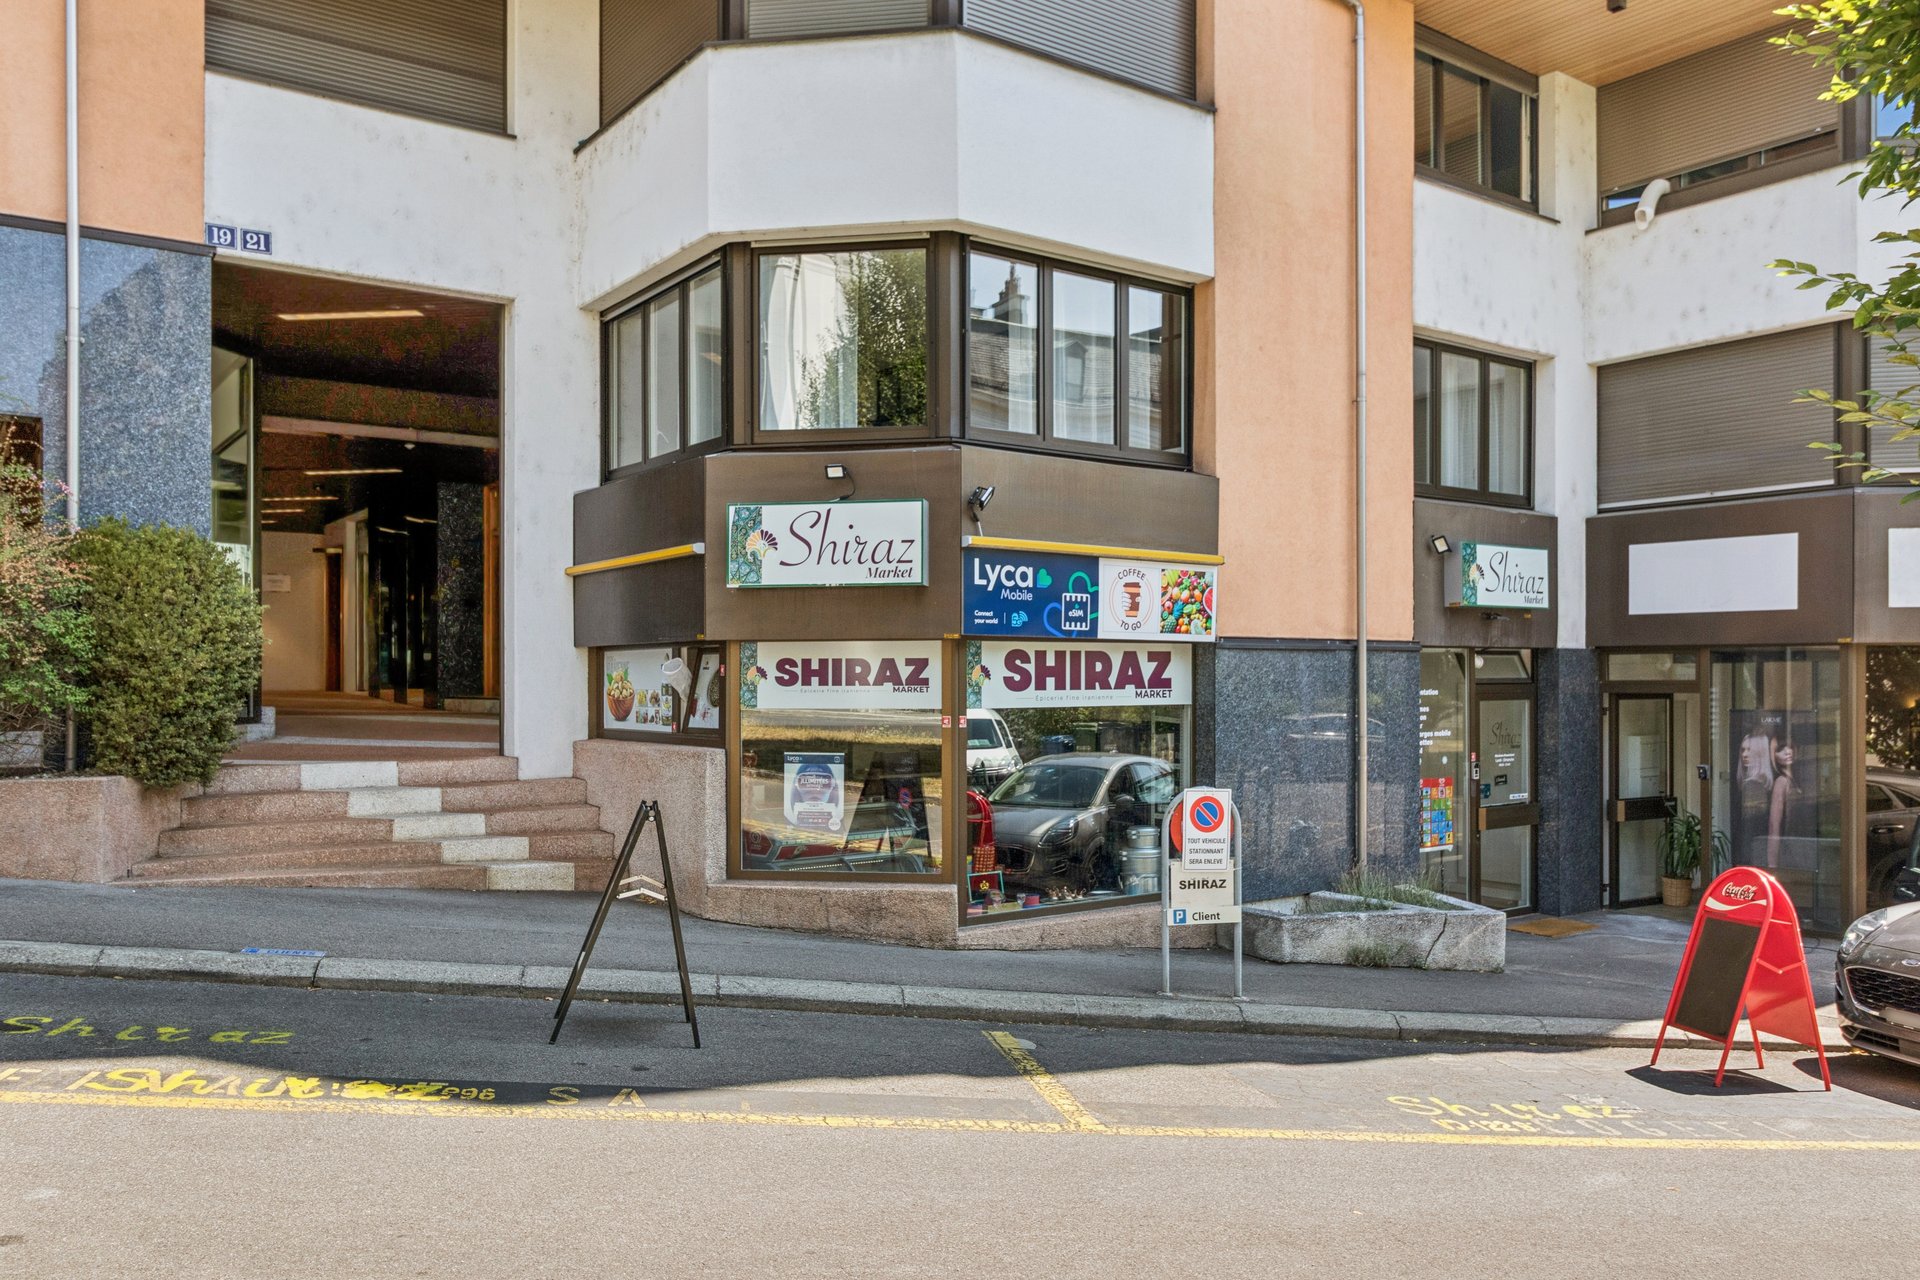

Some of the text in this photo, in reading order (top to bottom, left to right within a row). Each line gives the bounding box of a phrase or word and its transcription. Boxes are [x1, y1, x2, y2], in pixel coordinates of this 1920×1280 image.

[212, 227, 231, 245] 19
[246, 233, 266, 251] 21
[779, 508, 915, 566] Shiraz
[865, 566, 913, 578] Market
[974, 557, 1034, 591] Lyca
[1117, 568, 1146, 581] COFFEE
[1485, 550, 1545, 594] Shiraz
[1000, 588, 1033, 601] Mobile
[1524, 595, 1544, 604] Market
[974, 609, 993, 617] Connect
[1068, 609, 1084, 617] eSIM
[1120, 620, 1142, 631] TO GO
[774, 657, 930, 687] SHIRAZ
[1002, 648, 1173, 692] SHIRAZ
[1135, 689, 1173, 698] MARKET
[1179, 879, 1227, 889] SHIRAZ
[1192, 911, 1221, 921] Client
